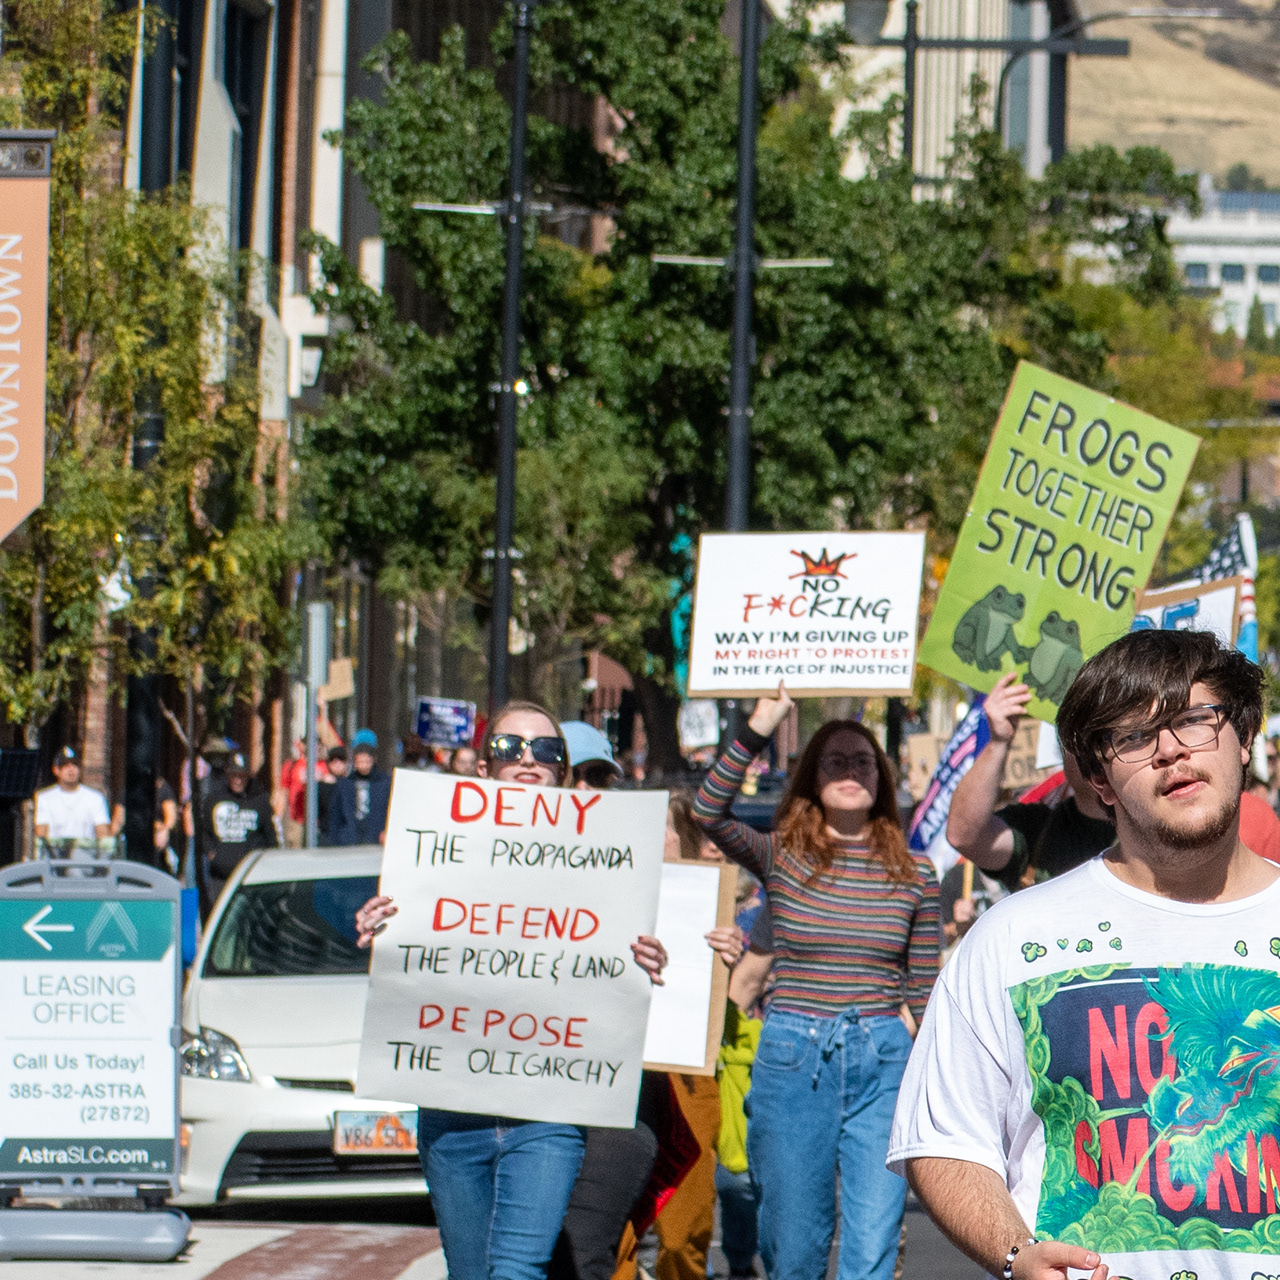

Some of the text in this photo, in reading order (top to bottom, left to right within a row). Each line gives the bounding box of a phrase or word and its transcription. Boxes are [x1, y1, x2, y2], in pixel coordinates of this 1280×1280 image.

[1016, 389, 1173, 493] FROGS
[1001, 447, 1154, 553] TOGETHER
[977, 507, 1135, 612] STRONG
[801, 578, 840, 593] NO
[715, 630, 909, 645] WAY I'M GIVING UP
[715, 647, 909, 660] MY RIGHT TO PROTEST
[713, 664, 910, 676] IN THE FACE OF INJUSTICE
[451, 780, 602, 836] DENY
[405, 828, 634, 871] THE PROPAGANDA
[432, 897, 600, 942] DEFEND
[398, 944, 451, 975] THE
[460, 947, 547, 979] PEOPLE
[571, 954, 626, 979] LAND
[23, 975, 136, 997] LEASING
[33, 1002, 126, 1024] OFFICE
[418, 1003, 589, 1049] DEPOSE
[13, 1053, 146, 1073] Call Us Today!
[387, 1041, 624, 1088] THE OLIGARCHY
[1088, 1001, 1178, 1101] NO
[9, 1083, 146, 1099] 385-32-ASTRA
[80, 1105, 150, 1124] (27872)
[17, 1145, 150, 1165] AstraSLC.com
